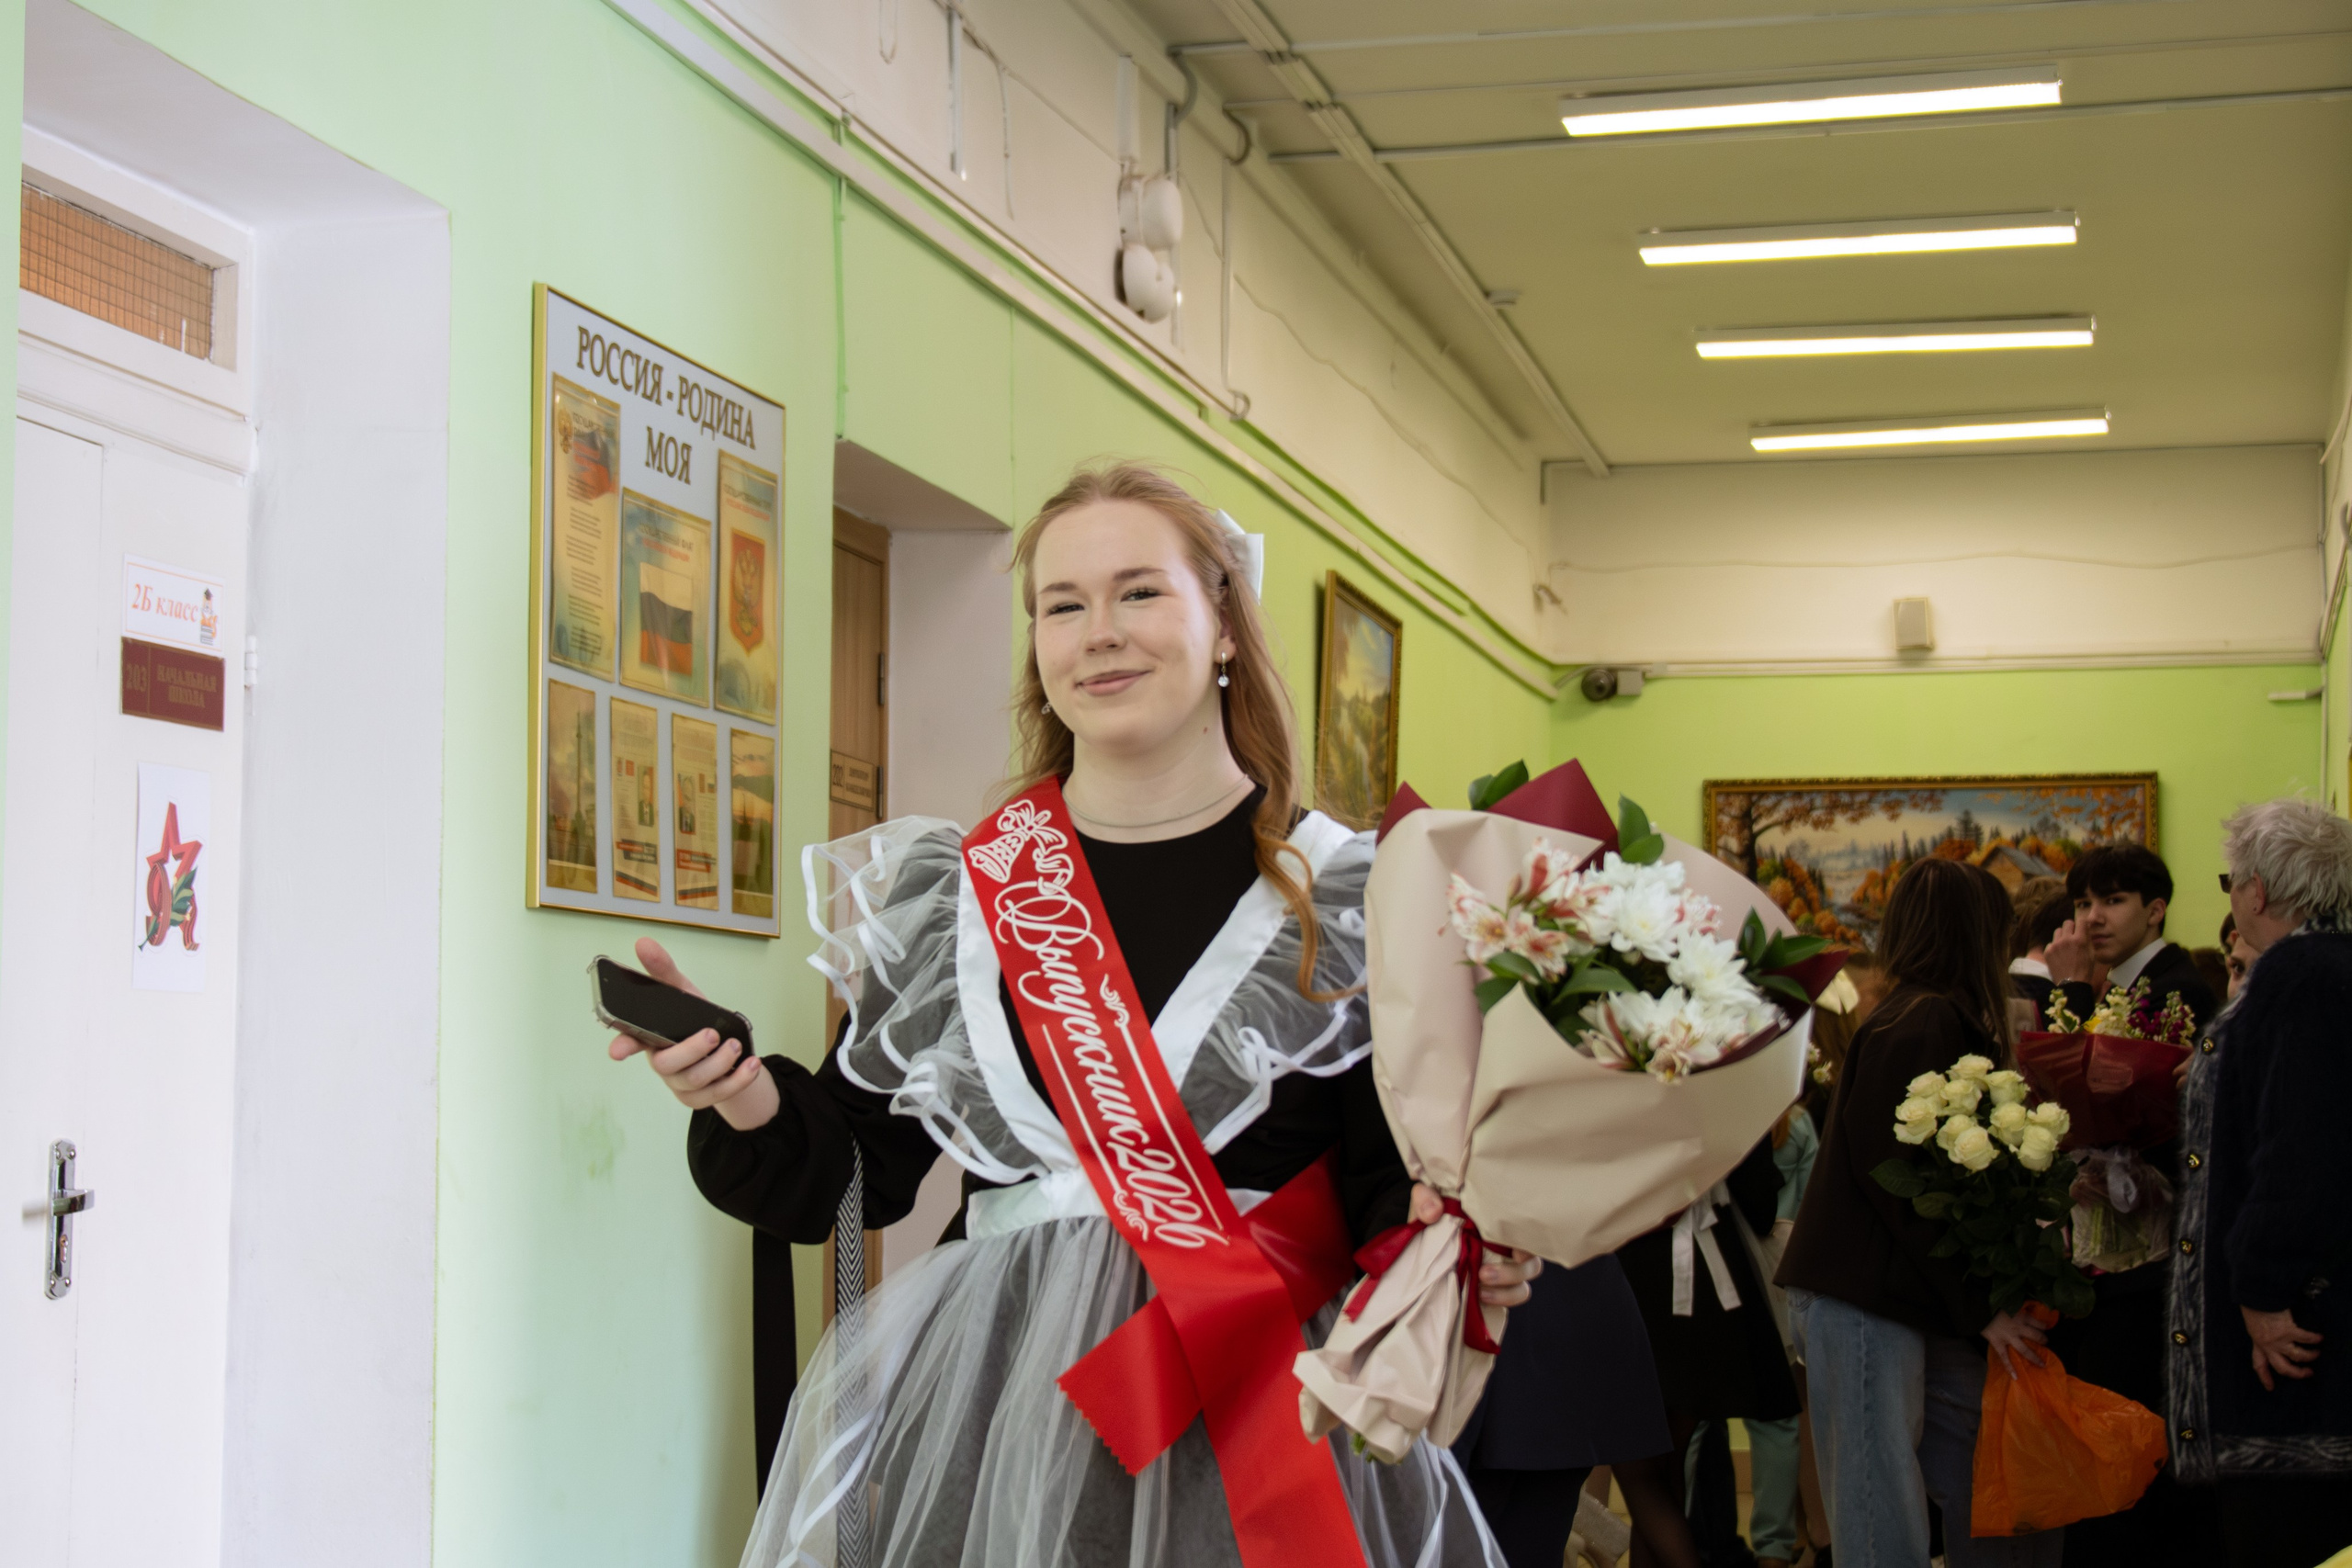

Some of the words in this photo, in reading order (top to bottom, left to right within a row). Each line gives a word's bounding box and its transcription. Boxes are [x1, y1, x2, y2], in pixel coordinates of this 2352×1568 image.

[577, 324, 663, 406] РОССИЯ
[677, 375, 756, 450] РОДИНА
[645, 425, 692, 486] МОЯ
[131, 582, 153, 612] 2Б
[155, 597, 199, 622] класс
